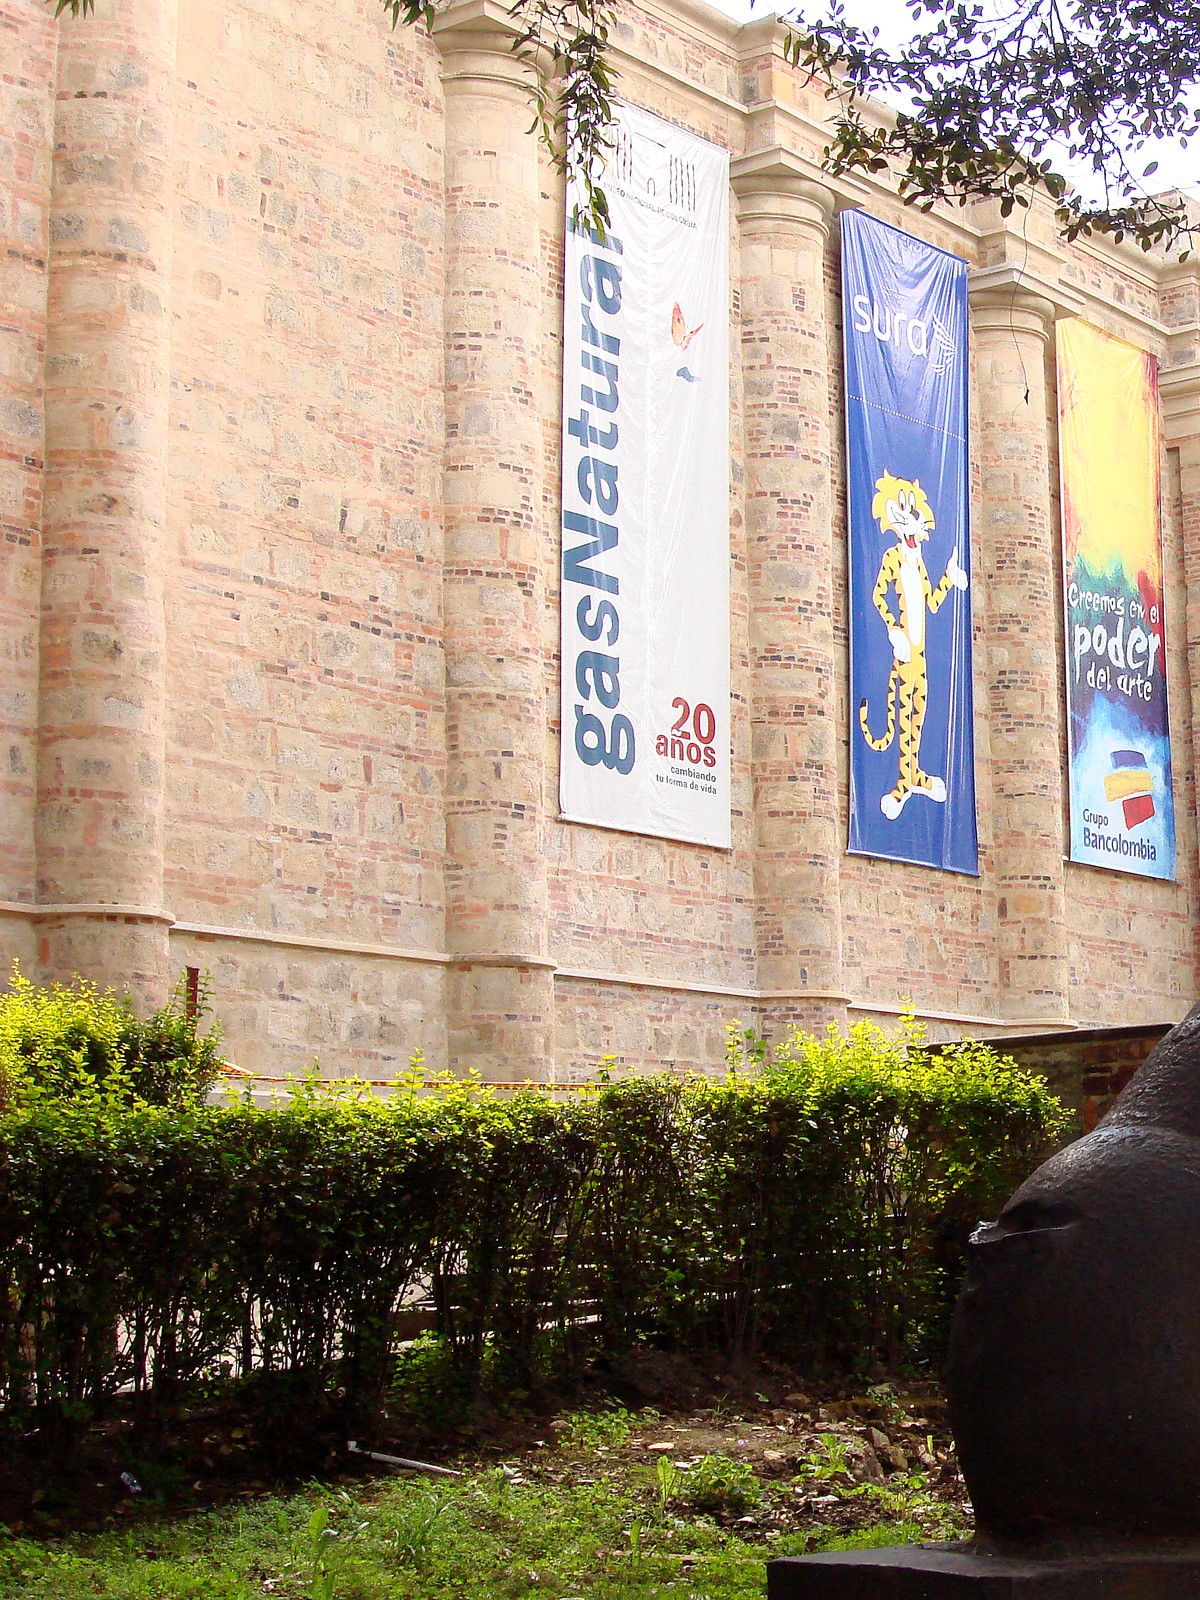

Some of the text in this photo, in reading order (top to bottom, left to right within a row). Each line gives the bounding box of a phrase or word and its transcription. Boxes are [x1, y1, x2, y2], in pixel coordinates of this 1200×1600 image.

[853, 293, 928, 360] sura
[1068, 582, 1160, 624] Creemos en el
[1074, 617, 1161, 684] poder
[1086, 661, 1153, 702] del arte
[671, 696, 716, 745] 20
[656, 734, 717, 768] años
[656, 774, 717, 795] tu forma de vida
[670, 766, 717, 783] cambiando
[1082, 808, 1109, 829] Grupo
[1083, 827, 1157, 862] Bancolombia
